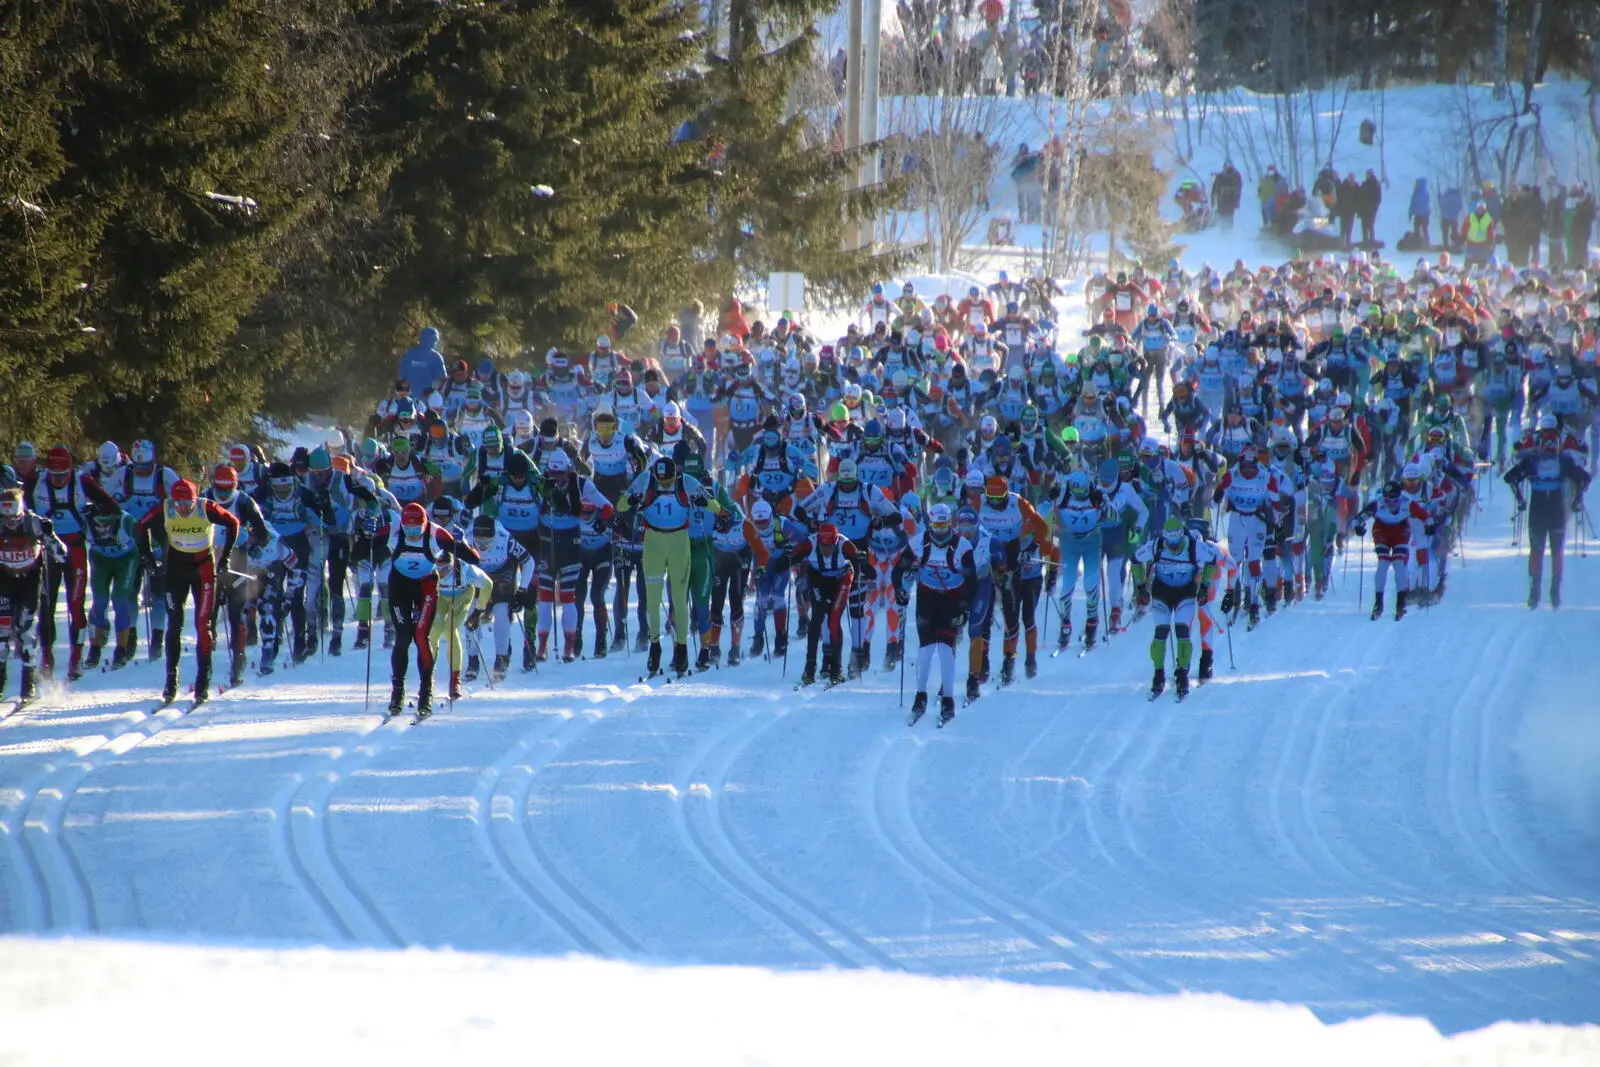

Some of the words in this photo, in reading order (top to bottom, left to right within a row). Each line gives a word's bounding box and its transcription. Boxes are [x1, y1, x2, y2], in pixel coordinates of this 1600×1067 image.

[764, 474, 784, 484] 29
[654, 502, 672, 516] 11
[836, 511, 856, 527] 31
[172, 525, 203, 534] Hertz
[408, 561, 420, 571] 2
